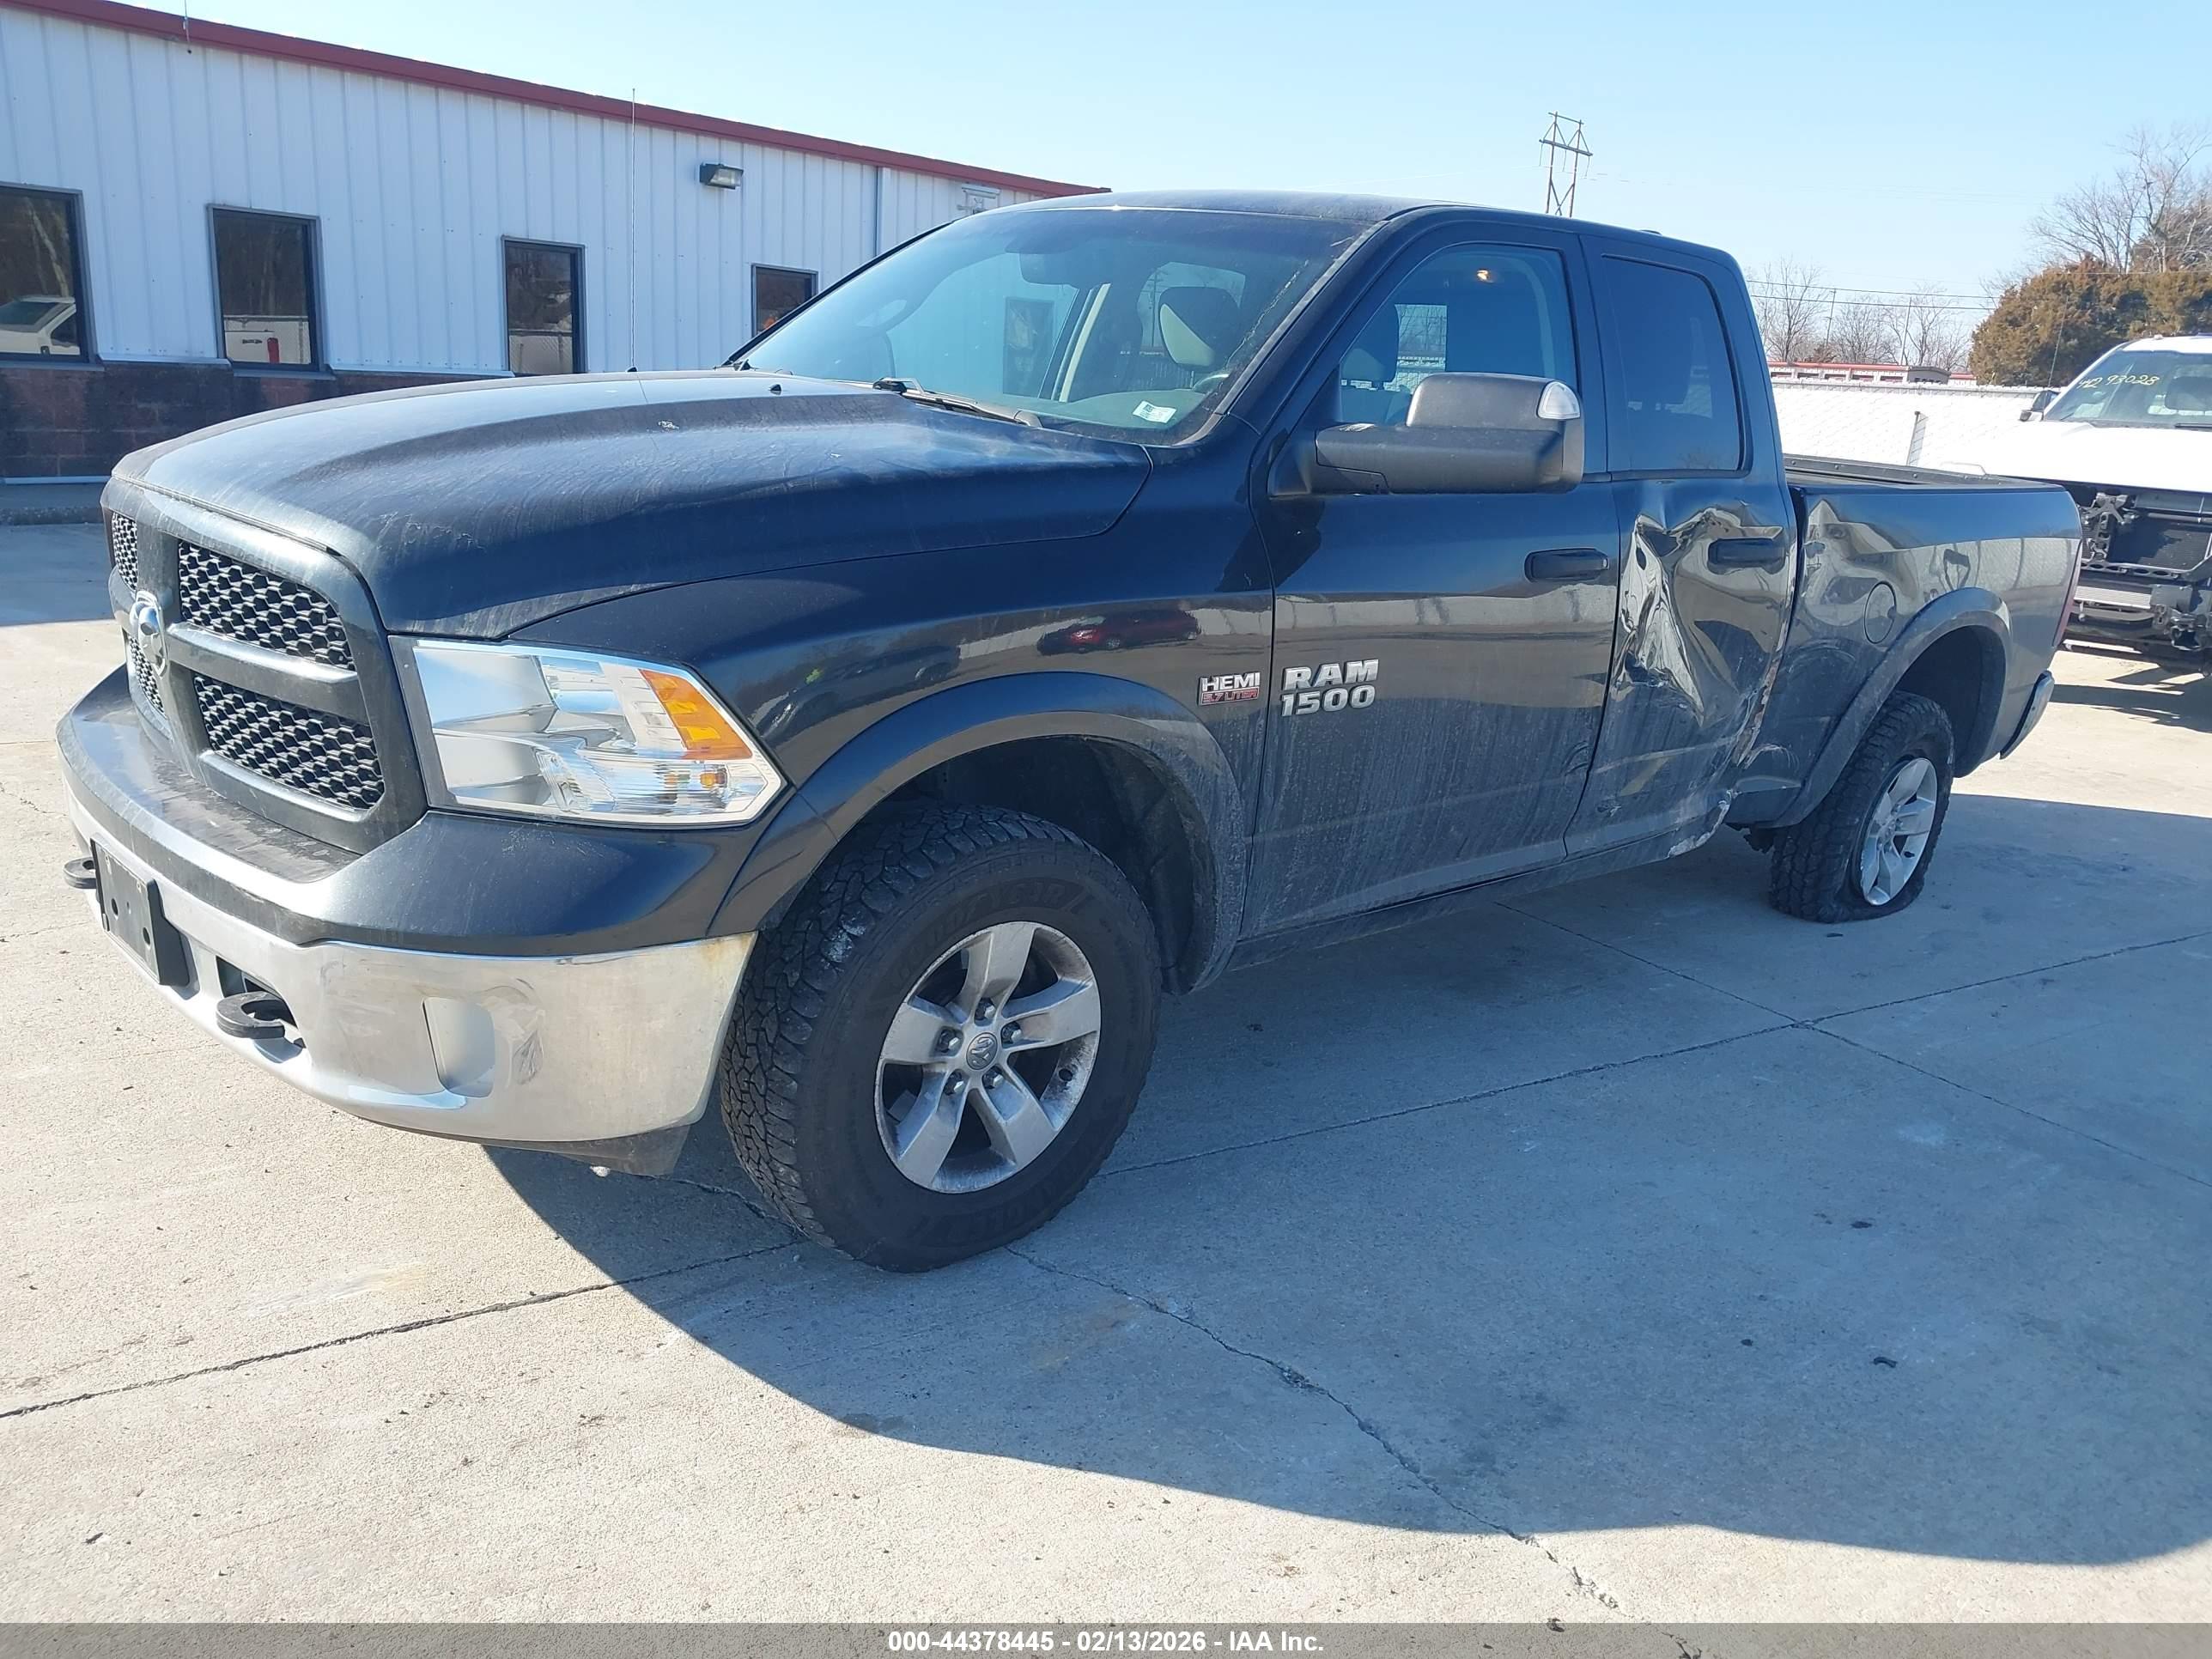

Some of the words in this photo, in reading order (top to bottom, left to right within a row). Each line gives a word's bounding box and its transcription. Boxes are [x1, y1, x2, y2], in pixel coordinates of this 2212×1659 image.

[2105, 374, 2160, 386] 93028
[1200, 672, 1261, 691] HEMI
[1284, 659, 1379, 690] RAM
[1203, 692, 1224, 703] 5.7
[1224, 689, 1258, 701] LITER
[1281, 684, 1376, 717] 1500
